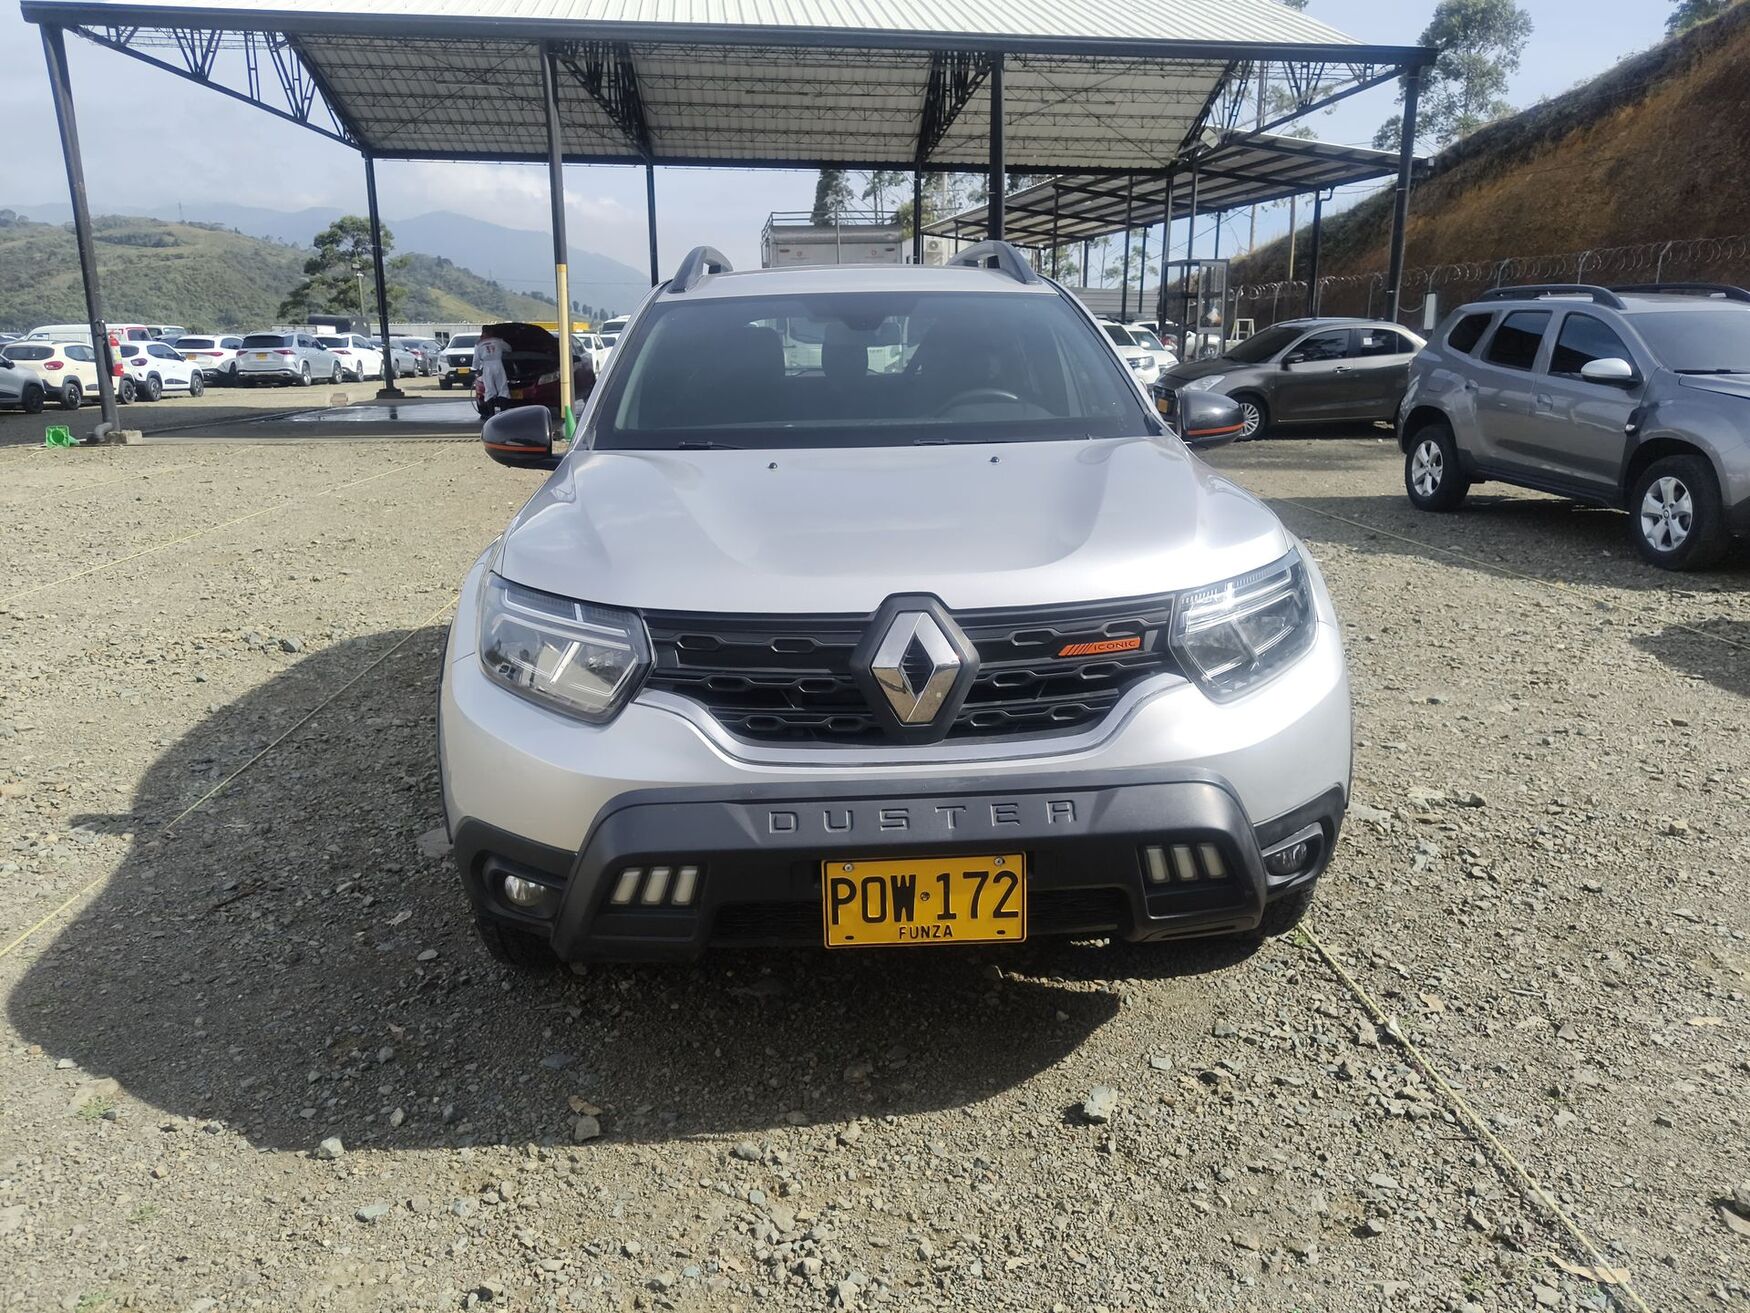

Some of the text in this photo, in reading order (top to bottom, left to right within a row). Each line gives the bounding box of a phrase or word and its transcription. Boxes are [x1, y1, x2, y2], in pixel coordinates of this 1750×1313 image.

[1094, 640, 1137, 651] ICONIC
[768, 799, 1078, 835] DUSTER
[829, 870, 1019, 926] POW 172
[899, 924, 953, 940] FUNZA
